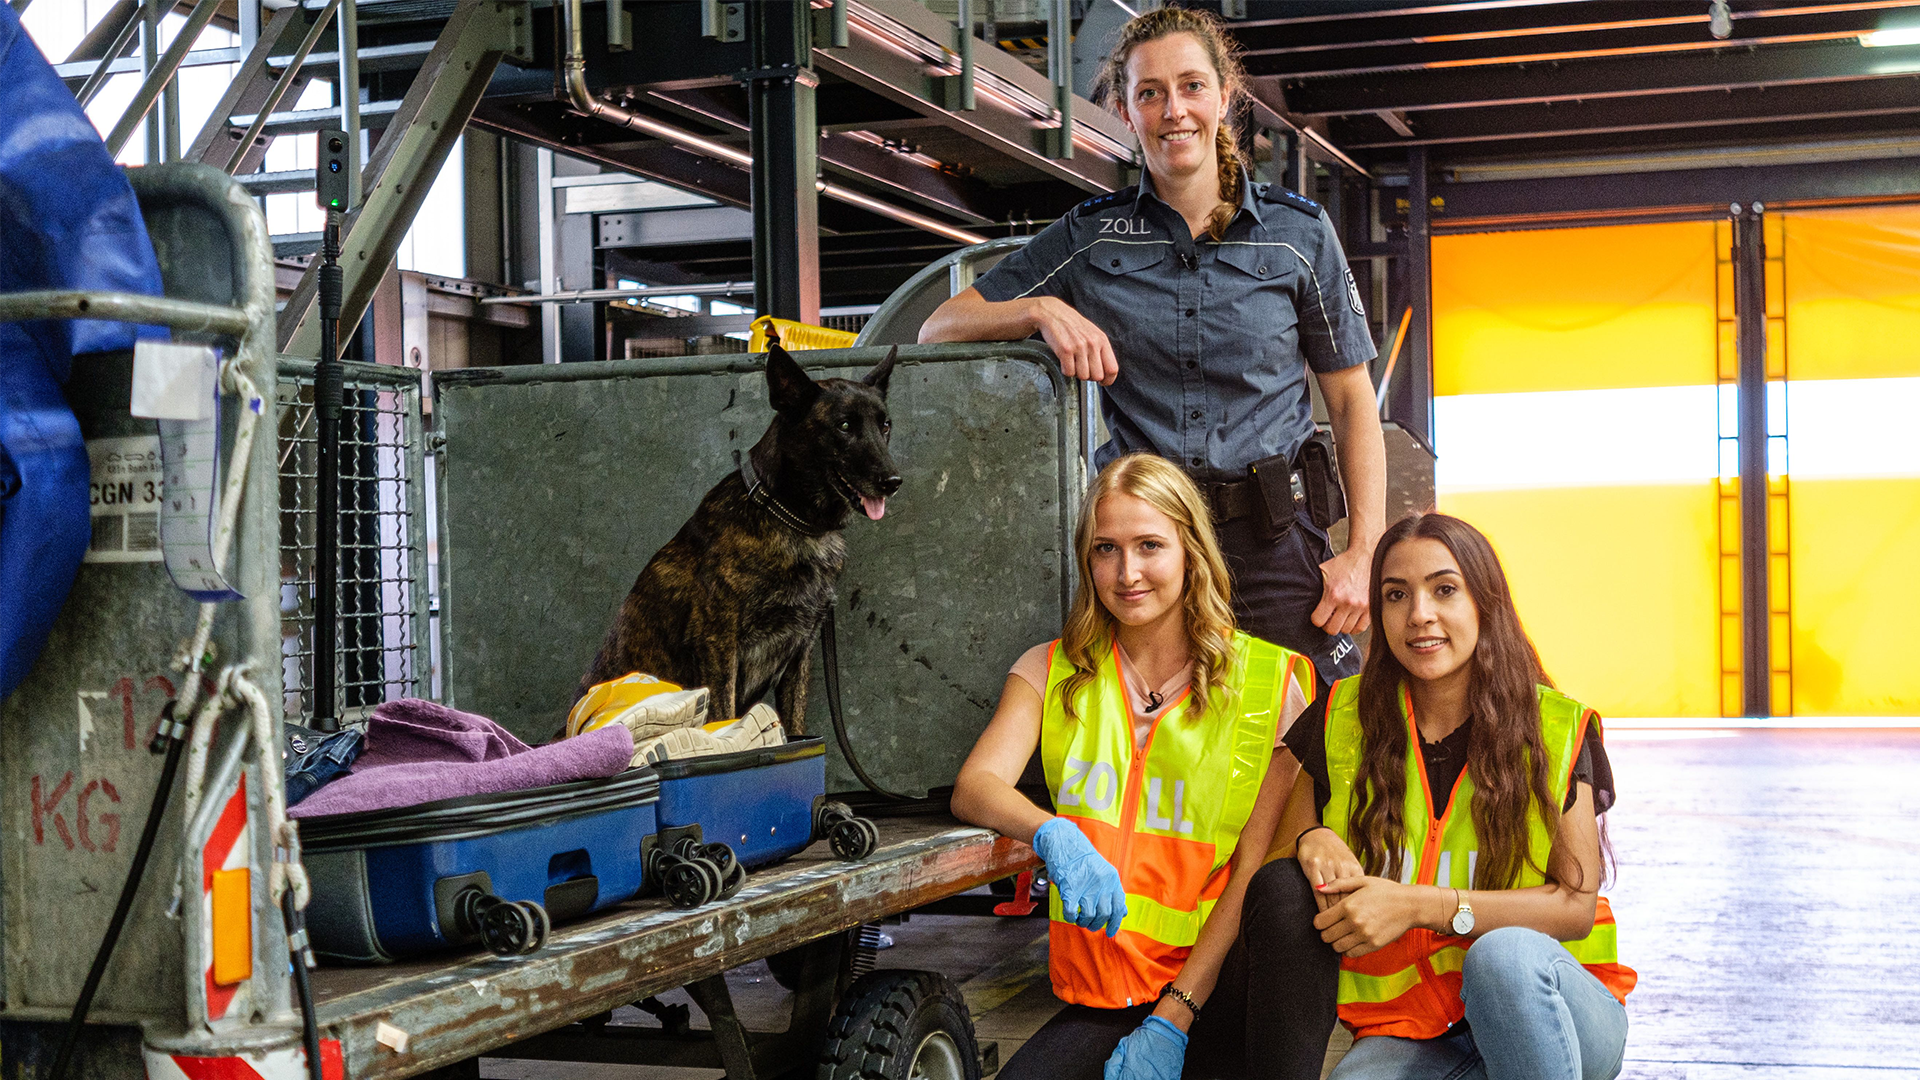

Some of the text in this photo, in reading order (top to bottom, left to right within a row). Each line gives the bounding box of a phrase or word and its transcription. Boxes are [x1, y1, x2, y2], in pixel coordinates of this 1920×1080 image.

[1098, 217, 1151, 235] ZOLL
[90, 481, 133, 505] CGN
[1329, 638, 1354, 666] ZOLL
[30, 770, 122, 852] KG
